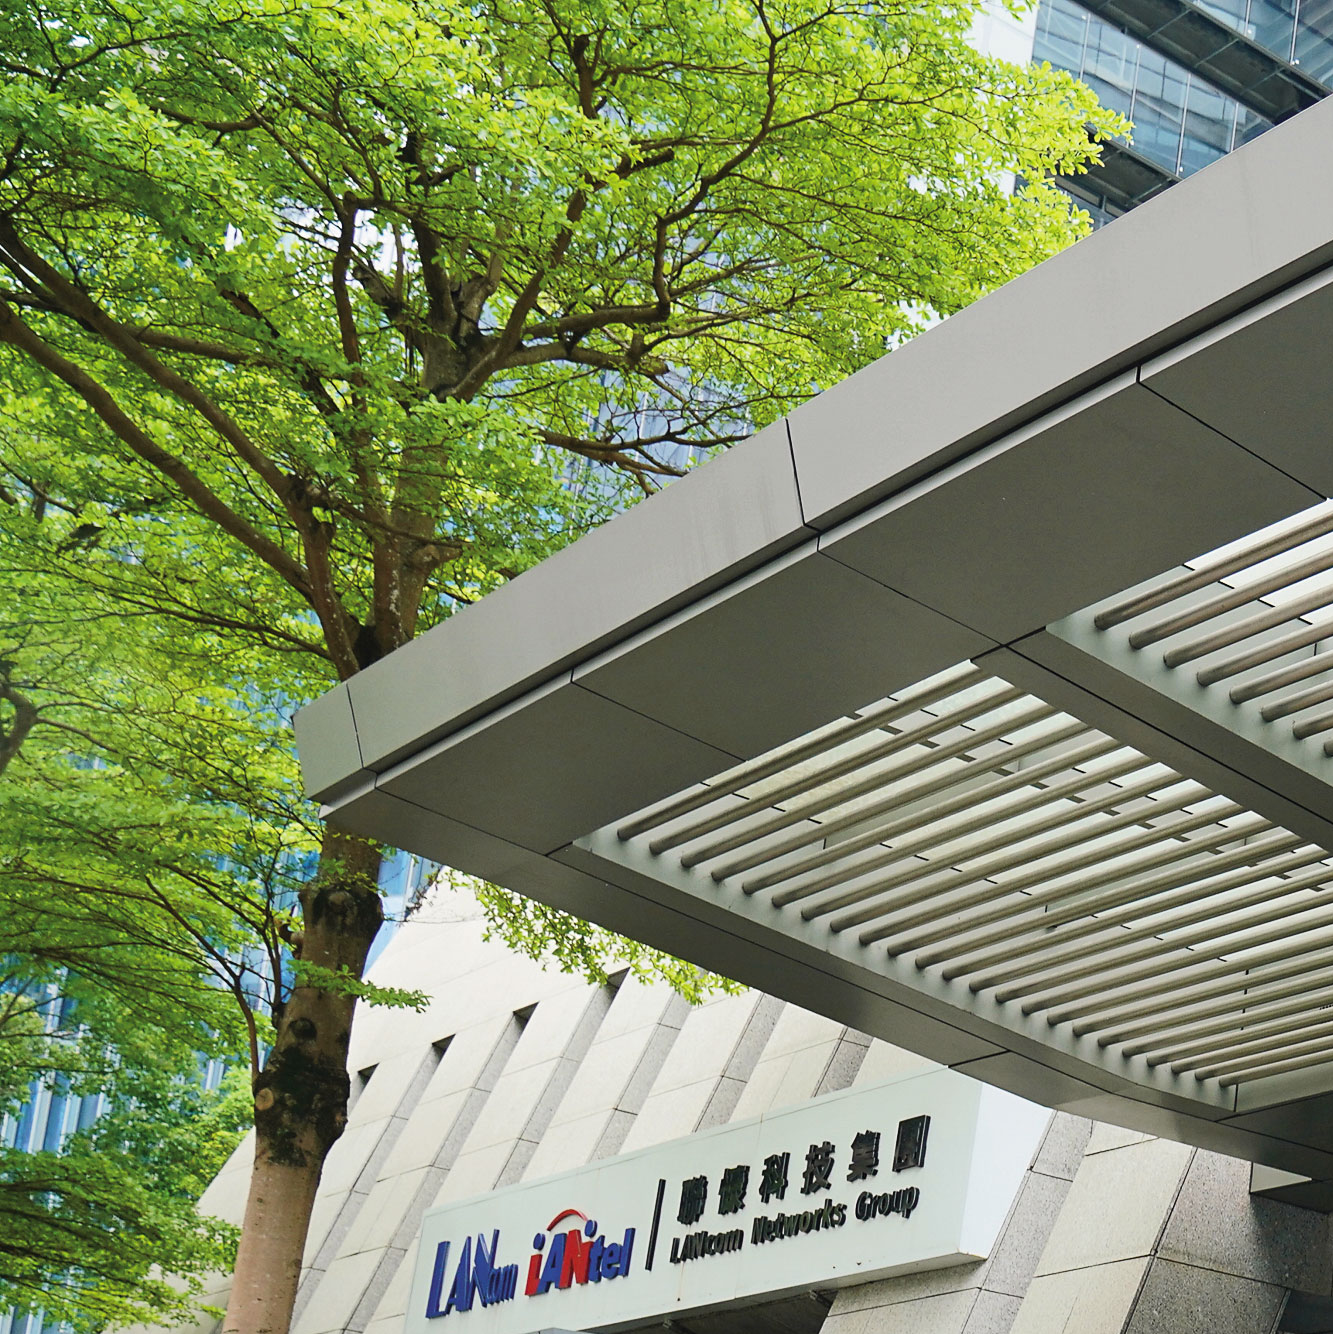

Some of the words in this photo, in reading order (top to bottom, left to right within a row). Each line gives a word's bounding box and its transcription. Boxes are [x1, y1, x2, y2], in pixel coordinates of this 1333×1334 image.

[670, 1229, 745, 1264] LANcom
[751, 1198, 848, 1245] Networks
[855, 1186, 920, 1221] Group
